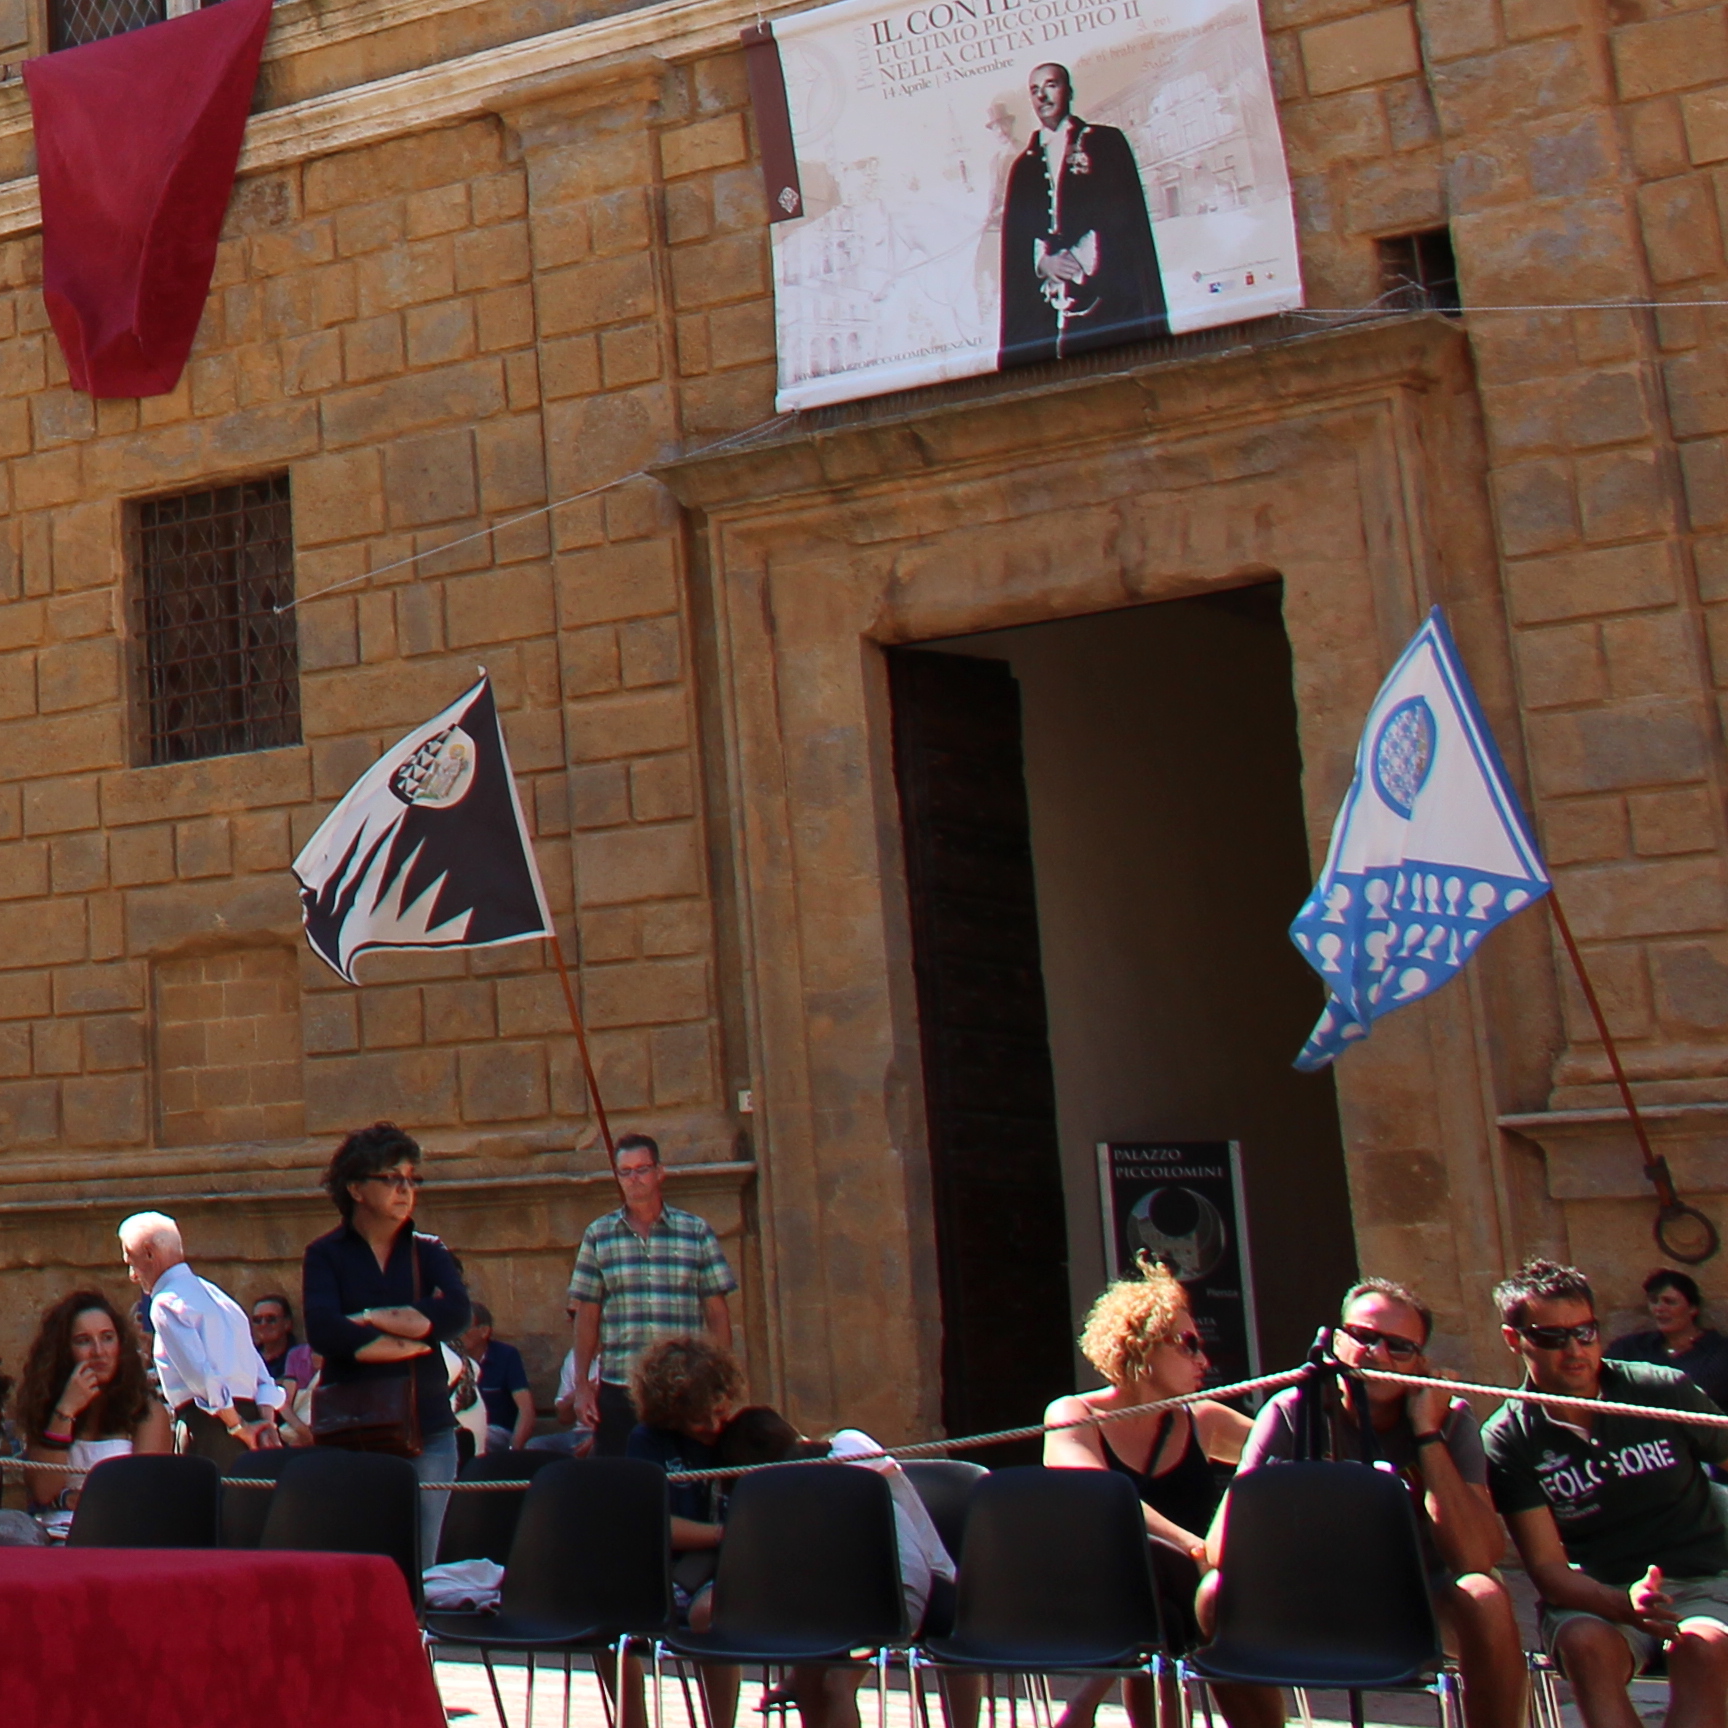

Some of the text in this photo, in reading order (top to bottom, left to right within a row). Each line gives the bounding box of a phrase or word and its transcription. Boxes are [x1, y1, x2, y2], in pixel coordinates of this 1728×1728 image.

[871, 19, 902, 46] IL
[874, 23, 978, 65] L'ULTIMO
[879, 50, 955, 85] NELLA
[1041, 19, 1069, 41] DI
[1075, 7, 1116, 32] PIO
[1122, 0, 1142, 20] II
[898, 76, 932, 98] Aprile
[952, 57, 1014, 81] Novembre
[1114, 1148, 1181, 1161] PALAZZO
[1115, 1165, 1223, 1179] PICCOLOMINI
